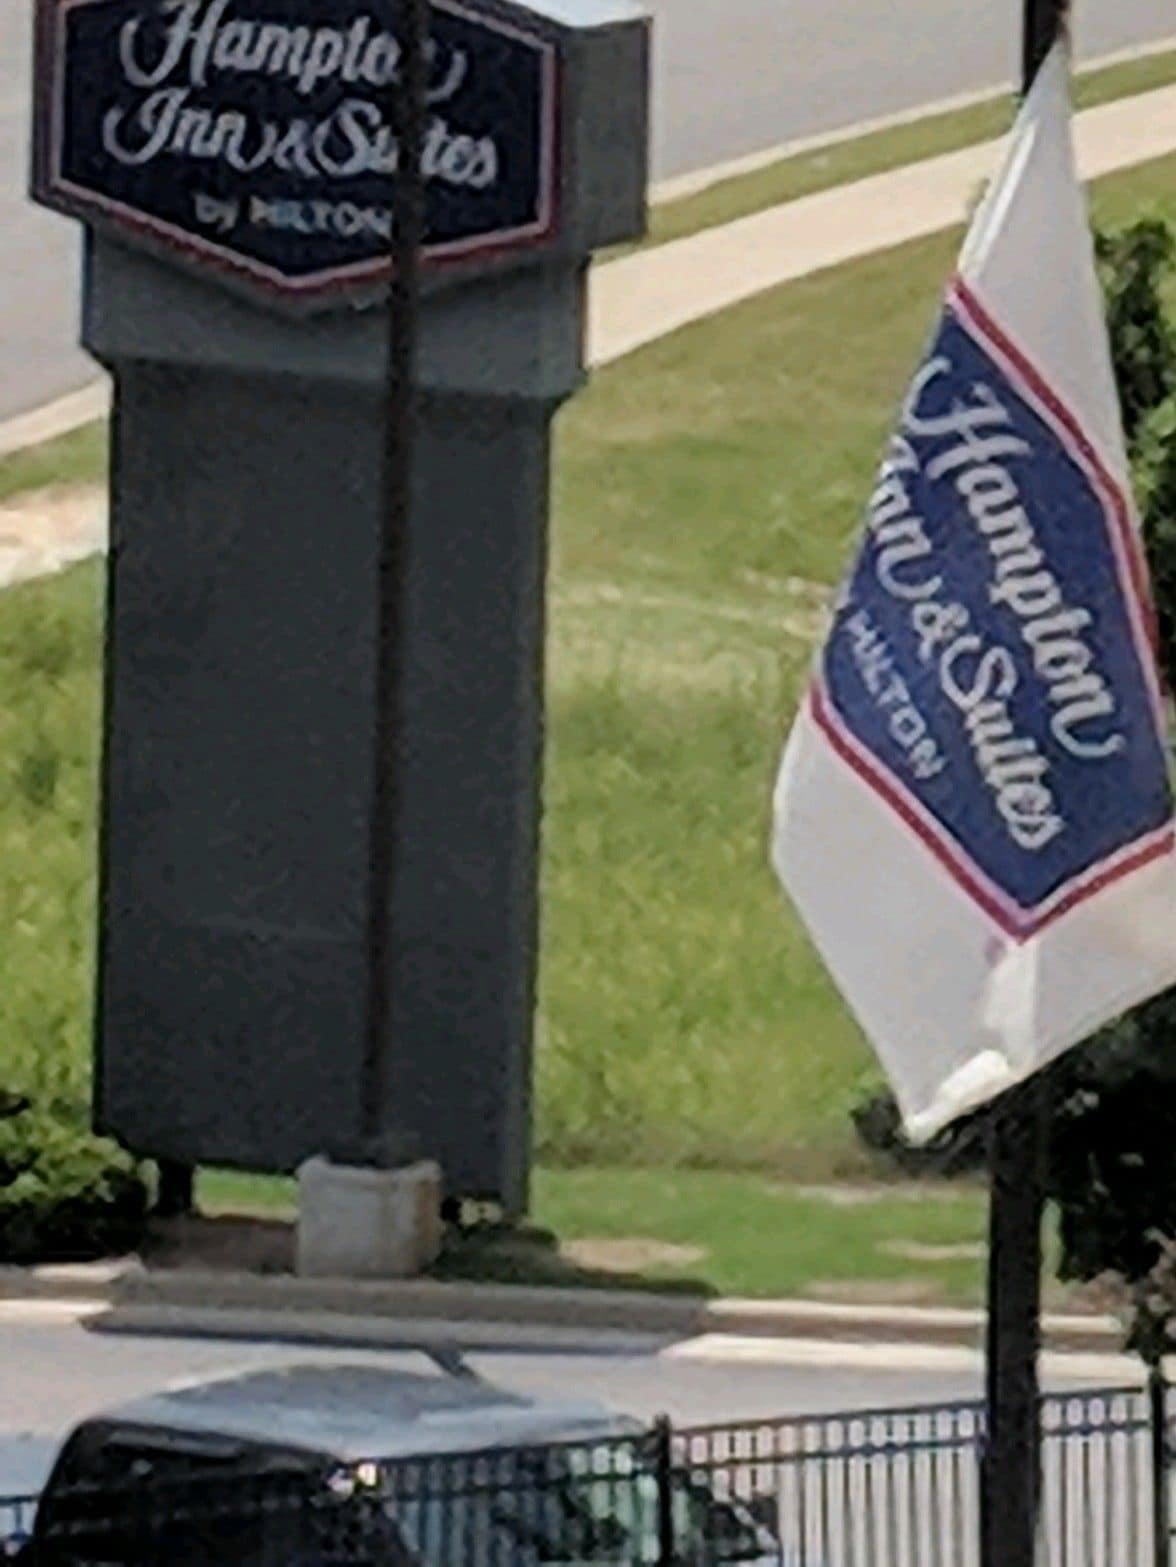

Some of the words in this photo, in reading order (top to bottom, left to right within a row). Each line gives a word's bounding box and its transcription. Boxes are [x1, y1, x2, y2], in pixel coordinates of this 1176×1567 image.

[102, 87, 280, 172] Inn
[312, 98, 498, 189] Sutes
[903, 356, 1125, 760] Hampton
[911, 600, 969, 663] &
[940, 633, 1066, 850] Suites
